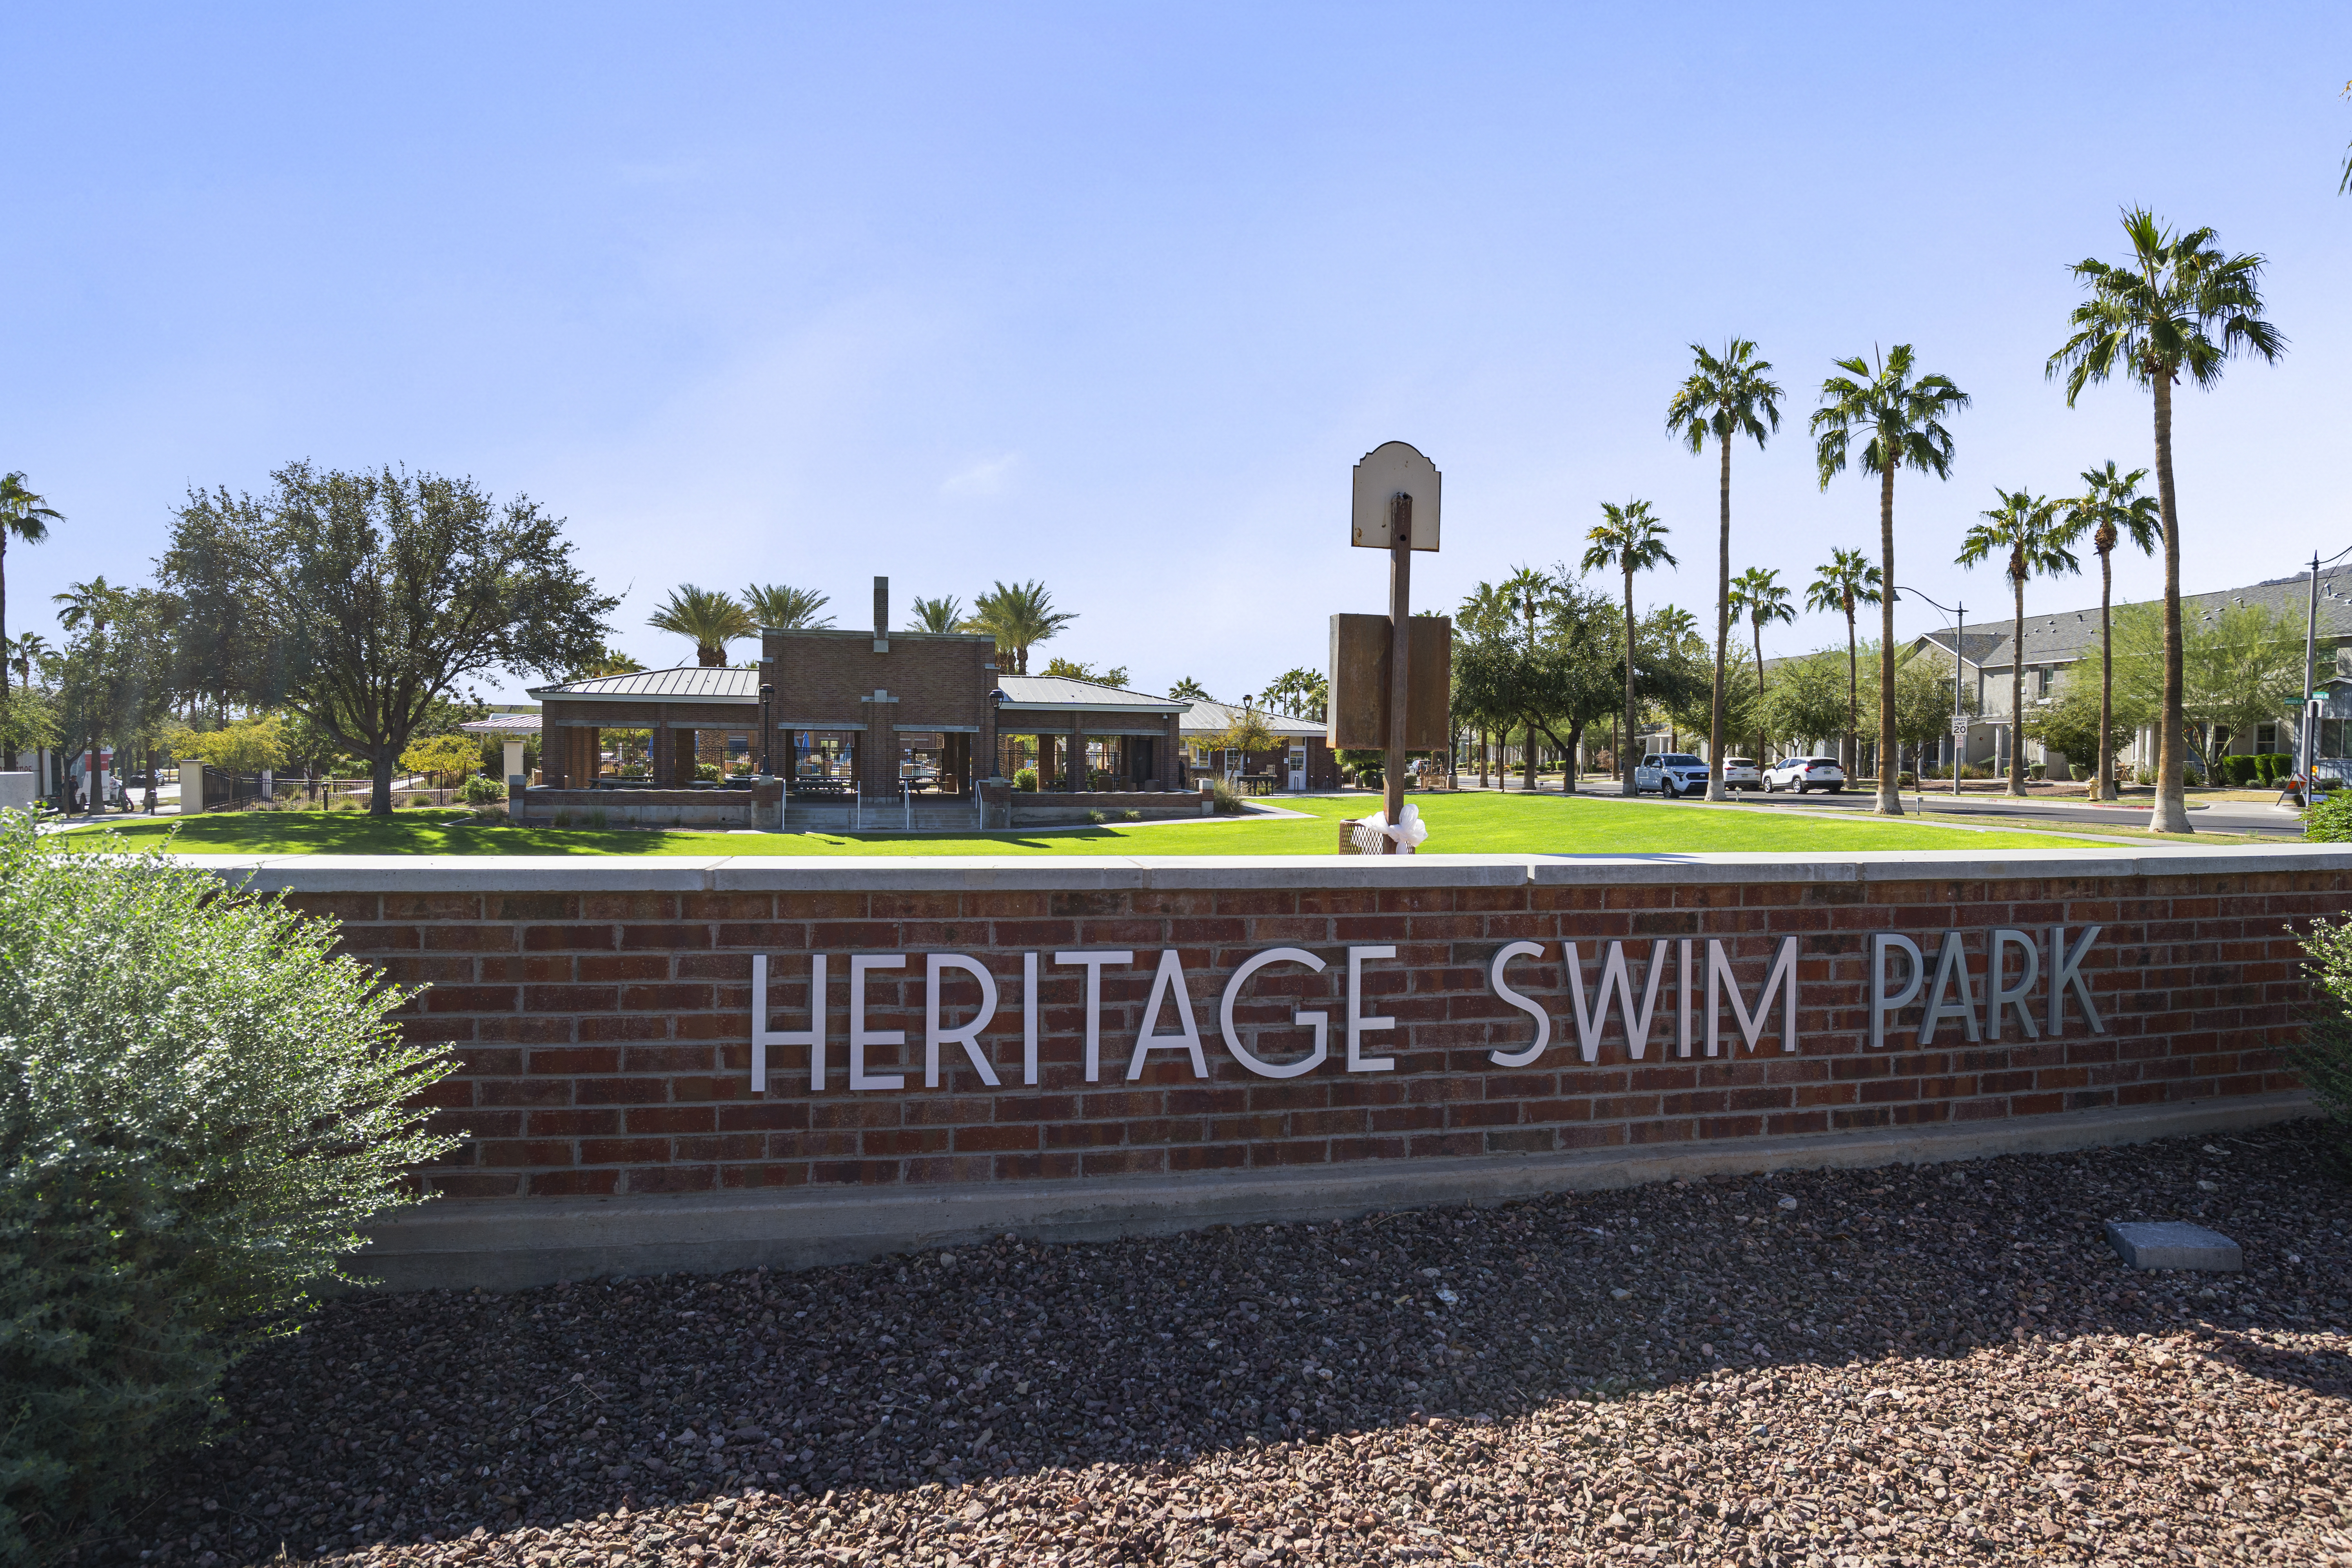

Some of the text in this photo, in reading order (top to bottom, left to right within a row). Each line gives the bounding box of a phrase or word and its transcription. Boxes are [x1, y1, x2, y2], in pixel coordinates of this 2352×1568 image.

[750, 926, 2105, 1092] HERITAGE SWIM PARK
